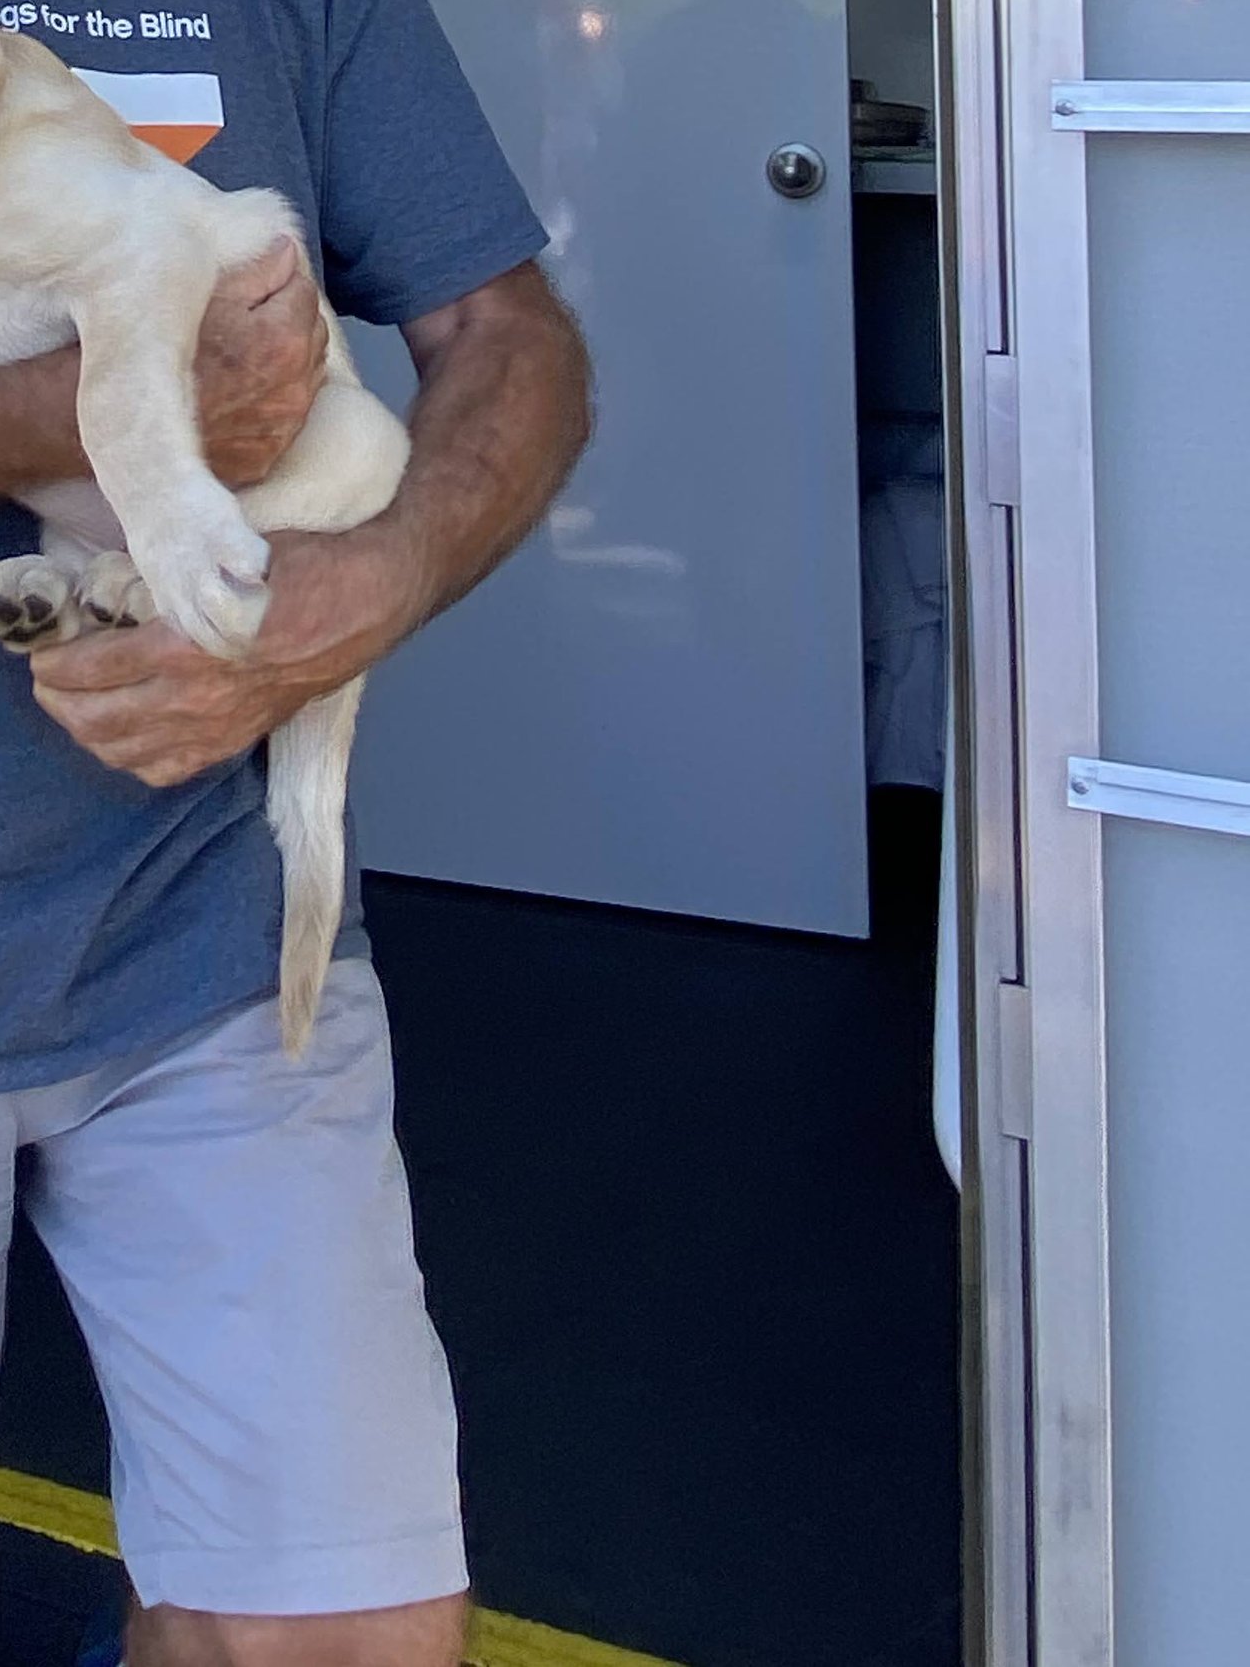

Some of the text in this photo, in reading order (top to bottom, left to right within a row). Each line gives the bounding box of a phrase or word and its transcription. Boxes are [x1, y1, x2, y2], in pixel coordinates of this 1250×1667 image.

[41, 5, 80, 35] for
[86, 9, 133, 40] the
[140, 10, 211, 40] Blind
